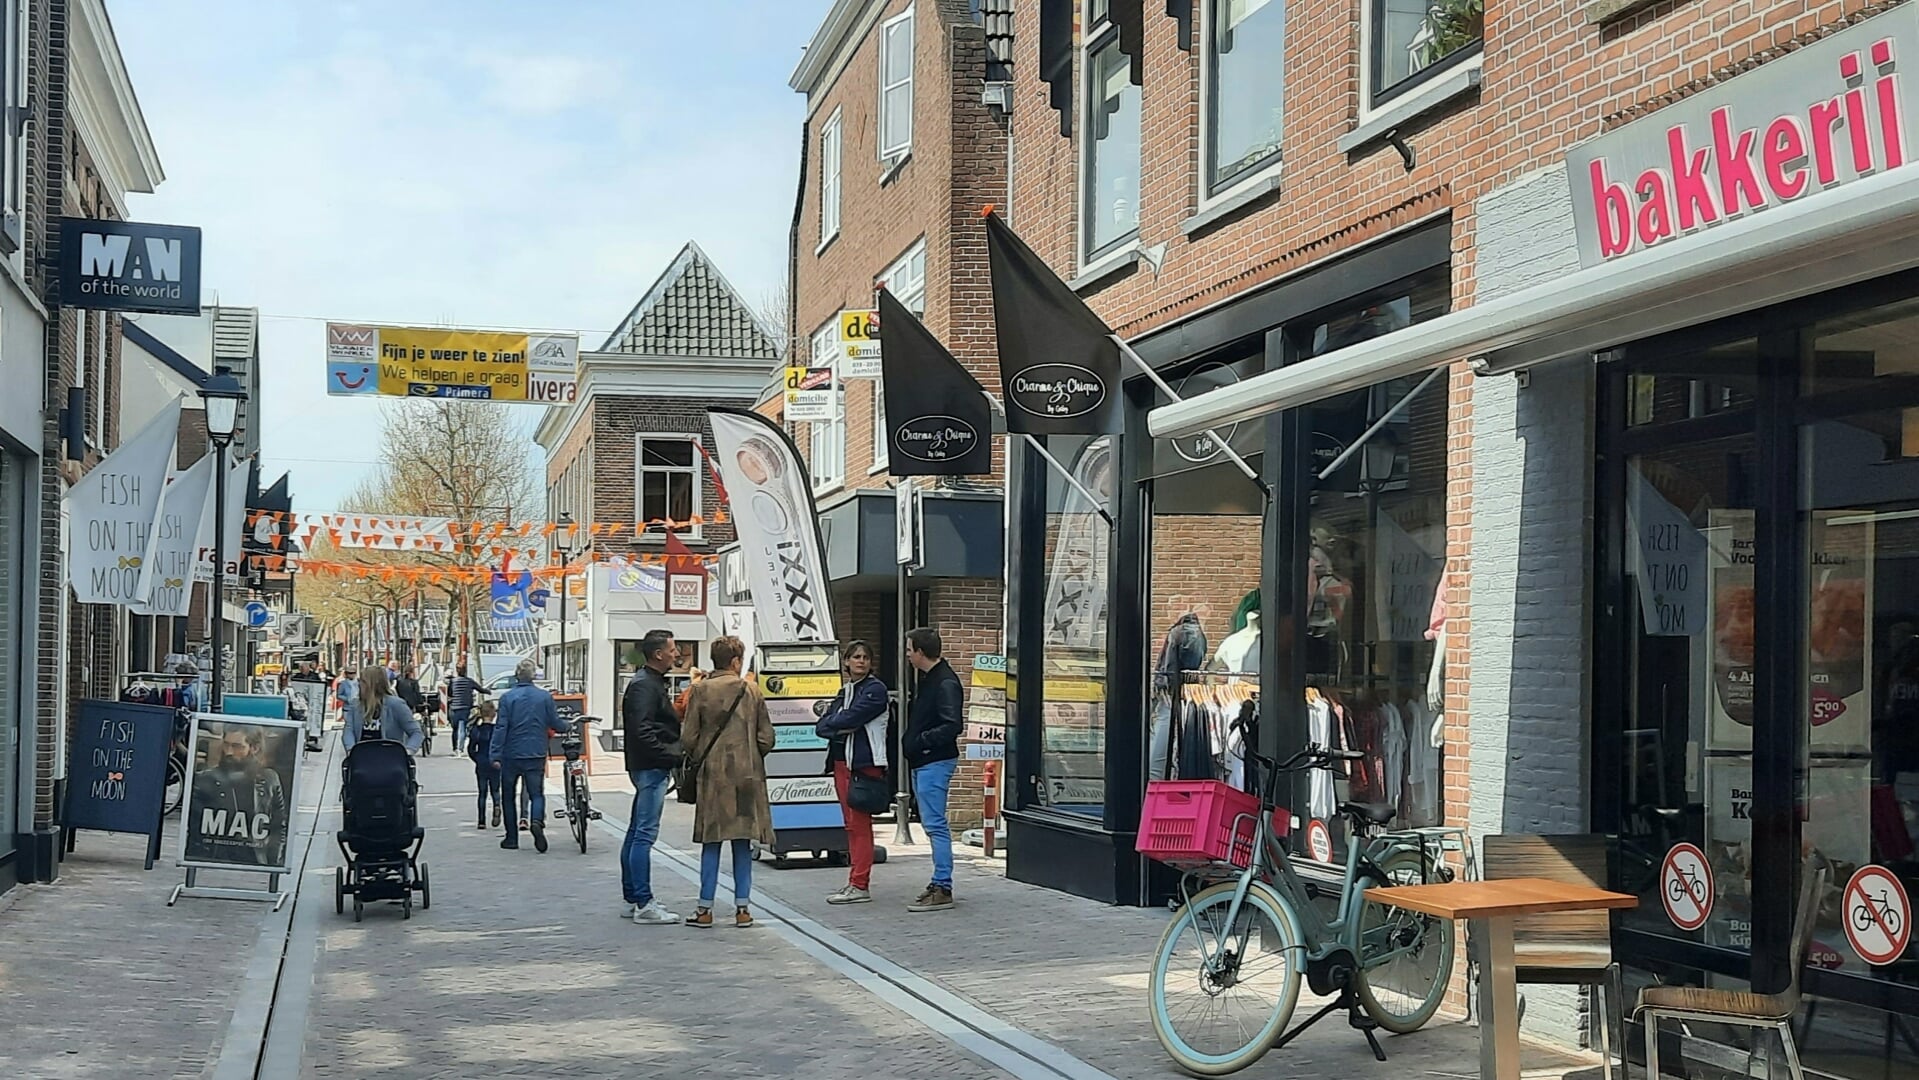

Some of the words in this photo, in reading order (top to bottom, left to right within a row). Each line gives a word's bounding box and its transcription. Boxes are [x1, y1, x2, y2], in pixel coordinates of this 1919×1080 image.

[81, 232, 181, 282] MAN
[81, 280, 103, 294] of
[103, 281, 130, 296] the
[134, 284, 181, 299] world
[382, 343, 407, 361] Fijn
[412, 345, 425, 362] je
[430, 349, 468, 361] weer
[473, 348, 487, 361] te
[492, 349, 525, 363] zien!
[382, 364, 407, 380] We
[412, 366, 458, 383] helpen
[462, 369, 475, 385] je
[445, 387, 489, 399] Primera
[1016, 377, 1053, 393] Charme
[1067, 378, 1099, 396] Chique
[901, 428, 933, 441] Charme
[101, 473, 141, 506] FISH
[89, 519, 117, 552] ON
[153, 551, 163, 575] N
[980, 655, 1007, 666] OOZ
[100, 720, 135, 745] FISH
[93, 748, 111, 768] ON
[115, 748, 134, 770] THE
[91, 779, 126, 801] MOON
[201, 808, 270, 840] MAC
